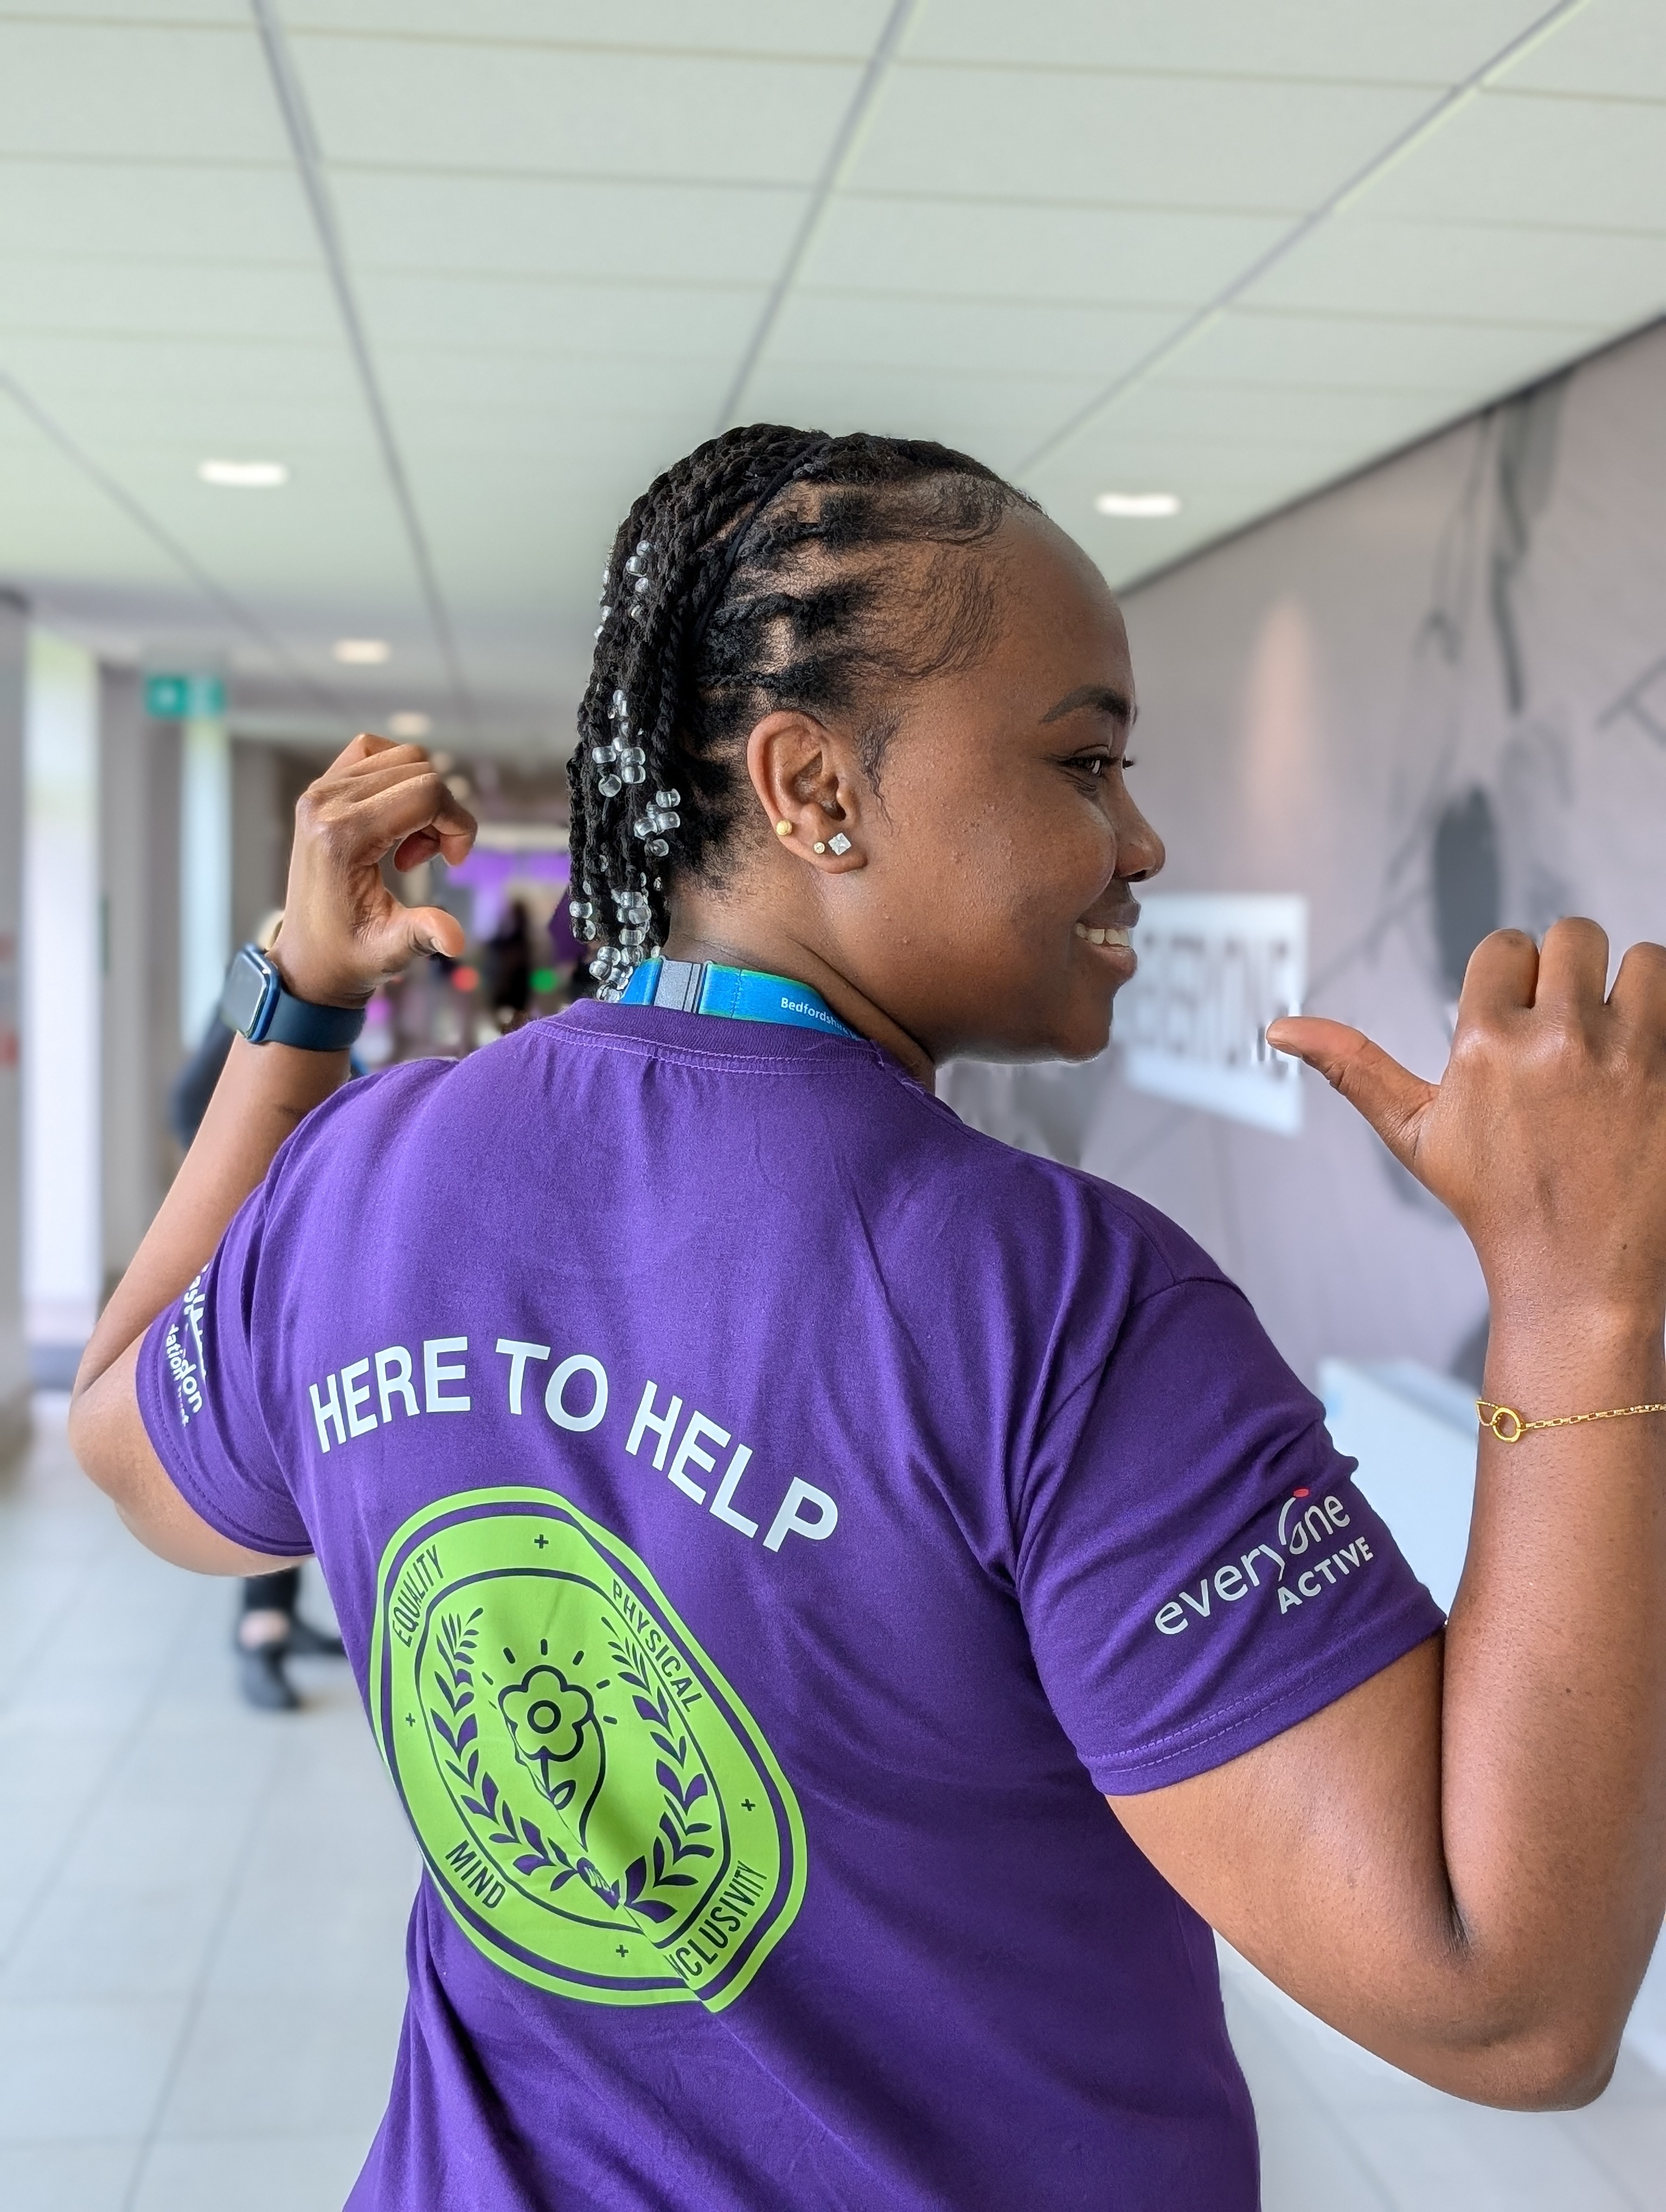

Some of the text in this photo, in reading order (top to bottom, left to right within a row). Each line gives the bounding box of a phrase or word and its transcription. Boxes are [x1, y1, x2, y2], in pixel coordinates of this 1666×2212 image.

[309, 1336, 838, 1552] HERE TO HELP
[392, 1544, 444, 1648] EQUALITY
[1155, 1488, 1350, 1635] everyone
[1277, 1536, 1374, 1615] ACTIVE
[613, 1578, 703, 1713] PHYSICAL
[445, 1839, 506, 1908] MIND
[662, 1860, 767, 1982] NCLUSIVITY
